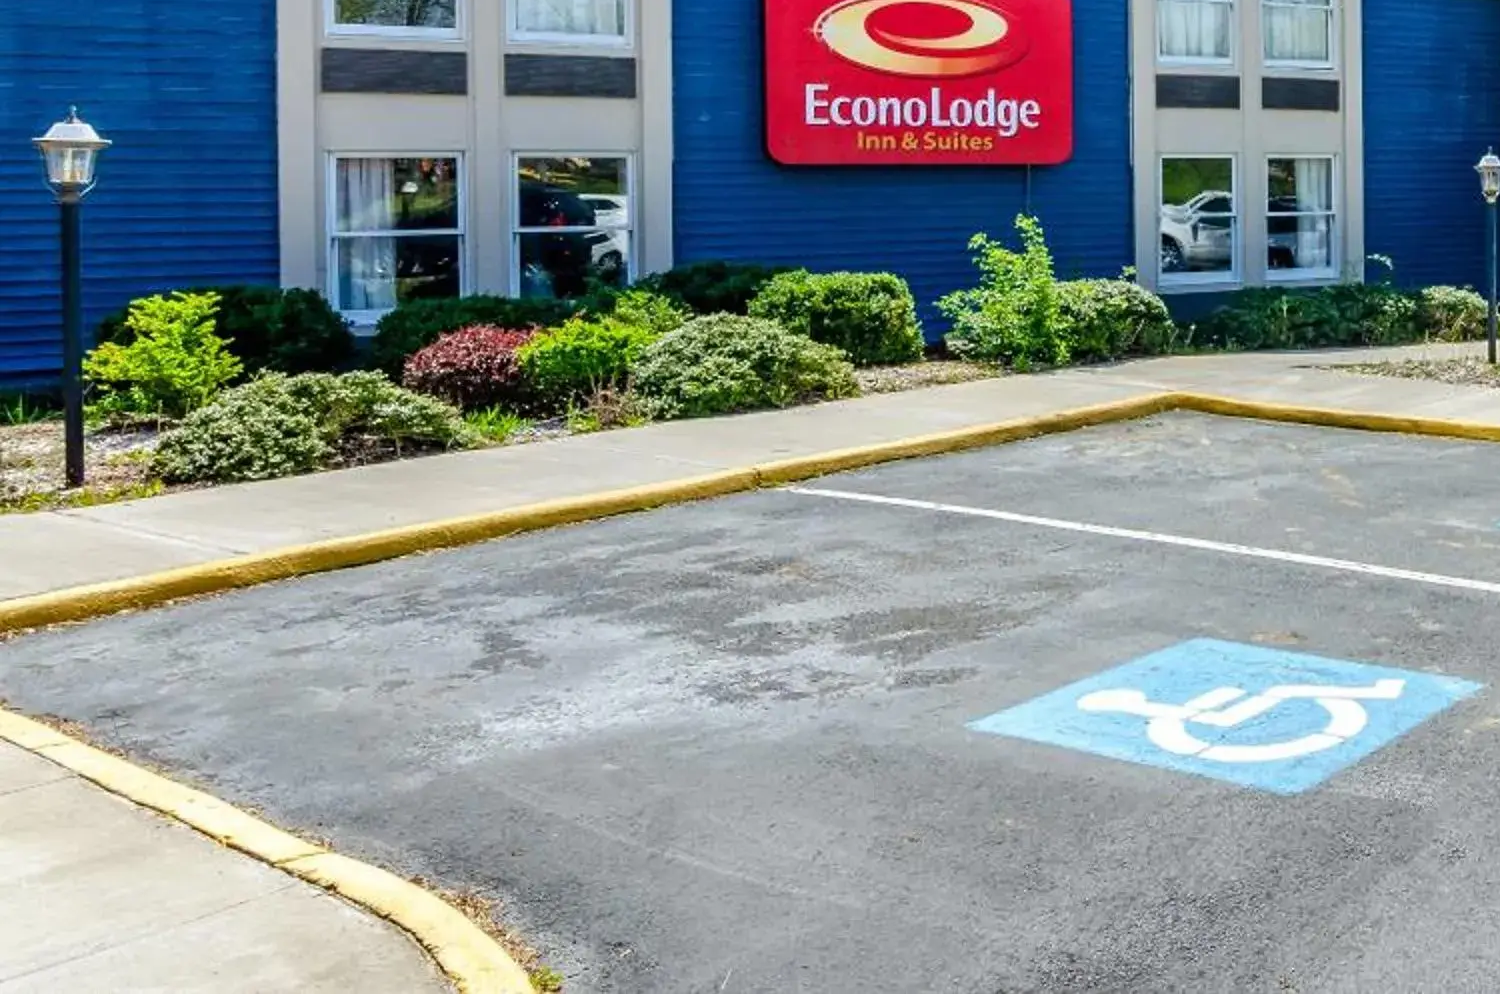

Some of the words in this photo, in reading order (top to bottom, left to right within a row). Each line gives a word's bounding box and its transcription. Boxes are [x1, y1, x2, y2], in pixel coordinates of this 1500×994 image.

[804, 83, 1041, 137] EconoLodge
[857, 131, 896, 150] Inn
[901, 132, 918, 151] &
[923, 132, 993, 151] Suites
